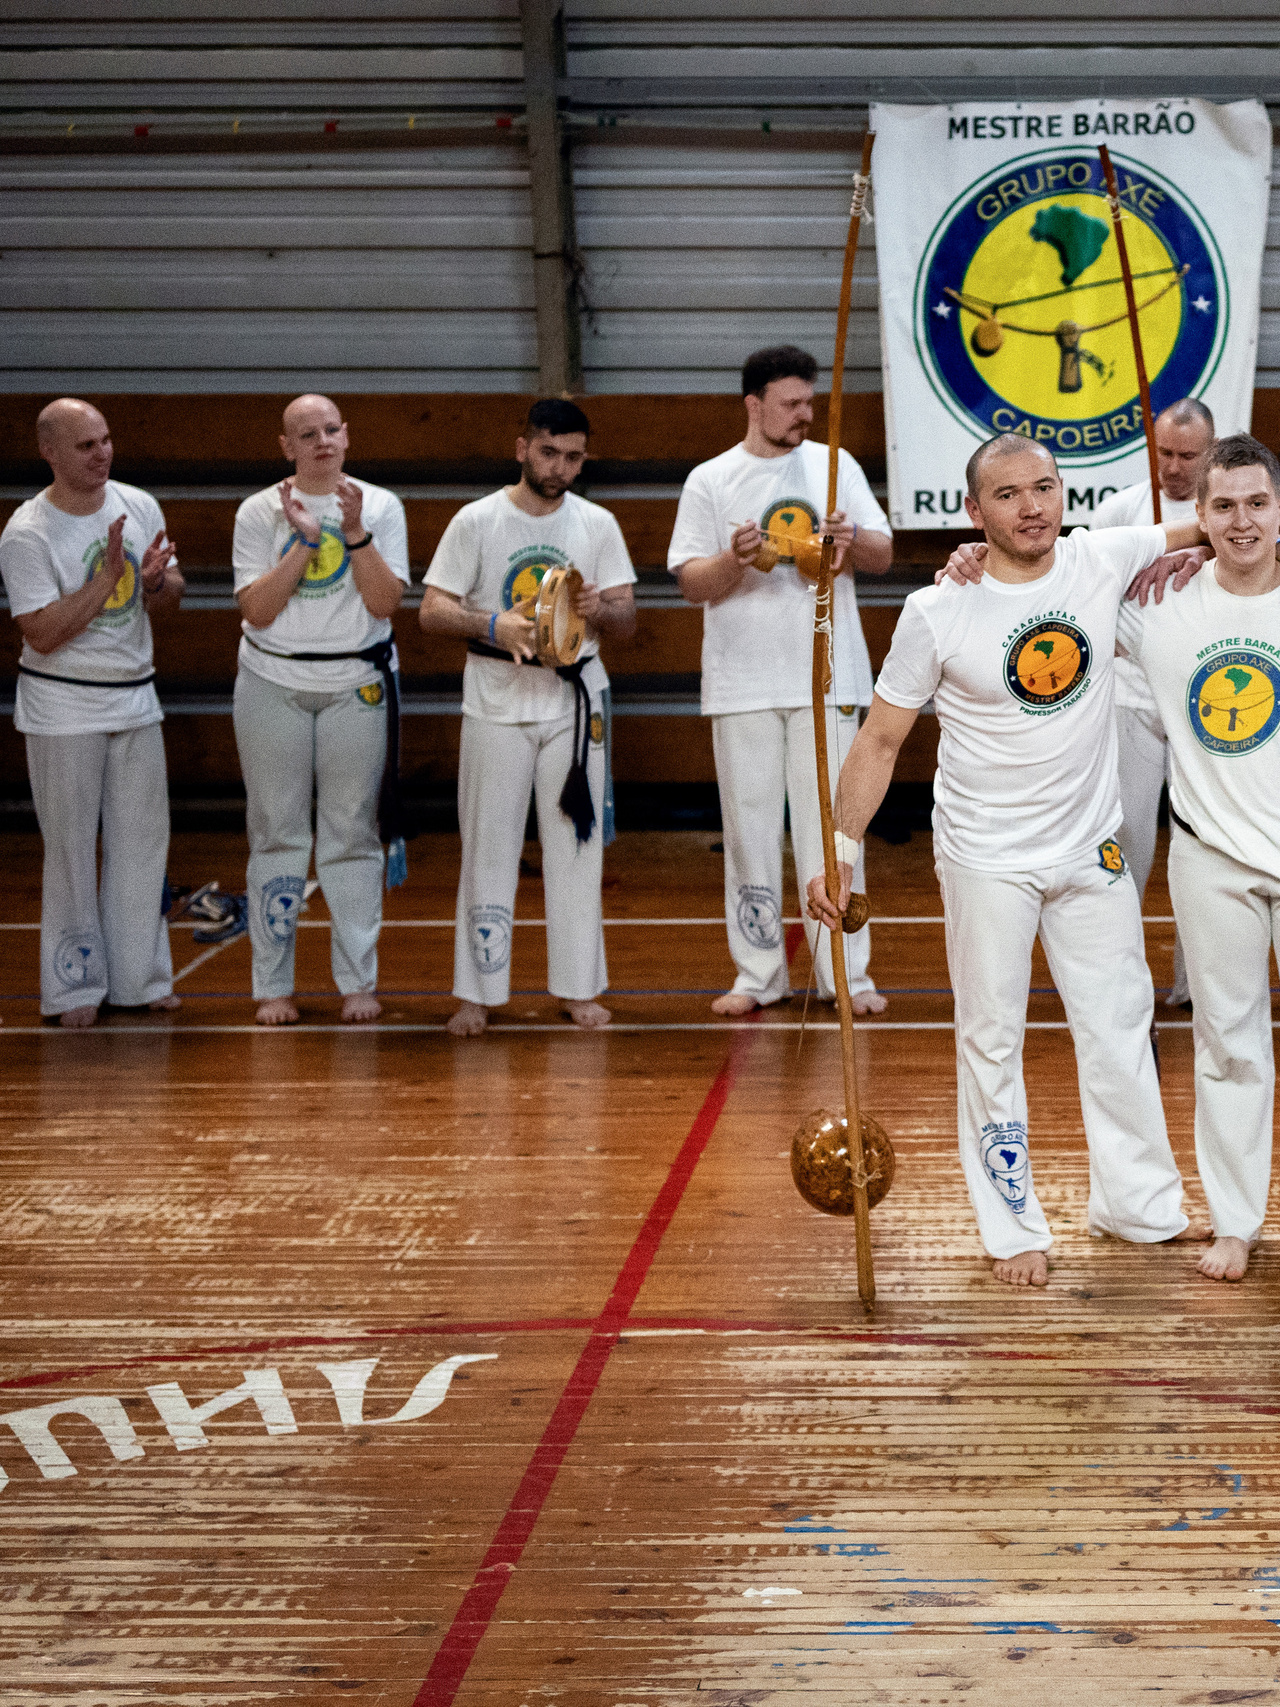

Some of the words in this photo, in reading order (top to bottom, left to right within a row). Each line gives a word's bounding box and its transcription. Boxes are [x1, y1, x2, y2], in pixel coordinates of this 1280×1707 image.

[948, 115, 1063, 139] MESTRE
[1073, 102, 1196, 136] BARRÃO
[976, 162, 1092, 221] GRUPO
[1042, 624, 1080, 640] CAPOEIRA
[1196, 637, 1241, 661] MESTRE
[1206, 654, 1248, 673] GRUPO
[1019, 705, 1063, 717] PROFESSOR
[1063, 678, 1092, 709] PARAFUSO
[1025, 693, 1056, 704] MESTRE
[1203, 735, 1260, 752] CAPOEIRA
